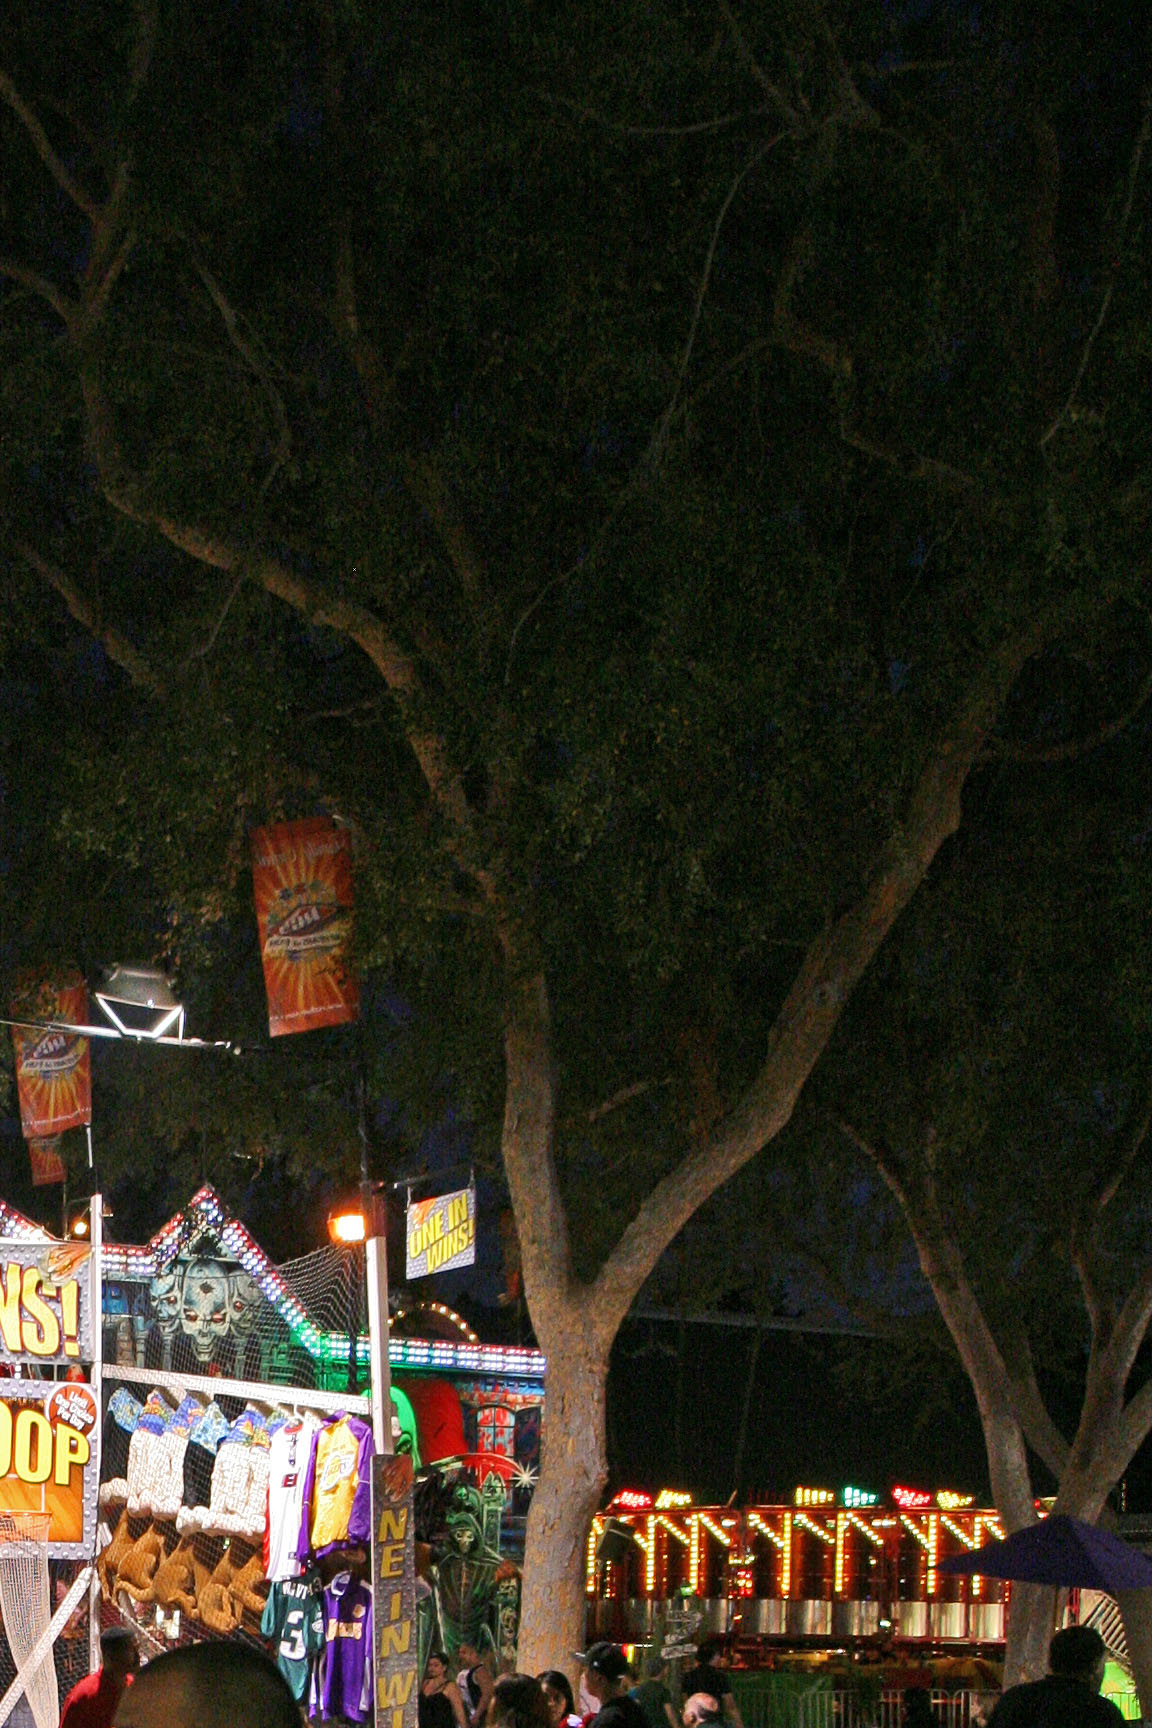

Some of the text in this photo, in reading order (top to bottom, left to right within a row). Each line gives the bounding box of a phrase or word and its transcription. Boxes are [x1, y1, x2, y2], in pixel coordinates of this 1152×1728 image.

[409, 1192, 468, 1259] ONE IN
[425, 1217, 475, 1275] WINS!
[55, 1394, 95, 1425] One Choice
[57, 1406, 86, 1431] Per Day
